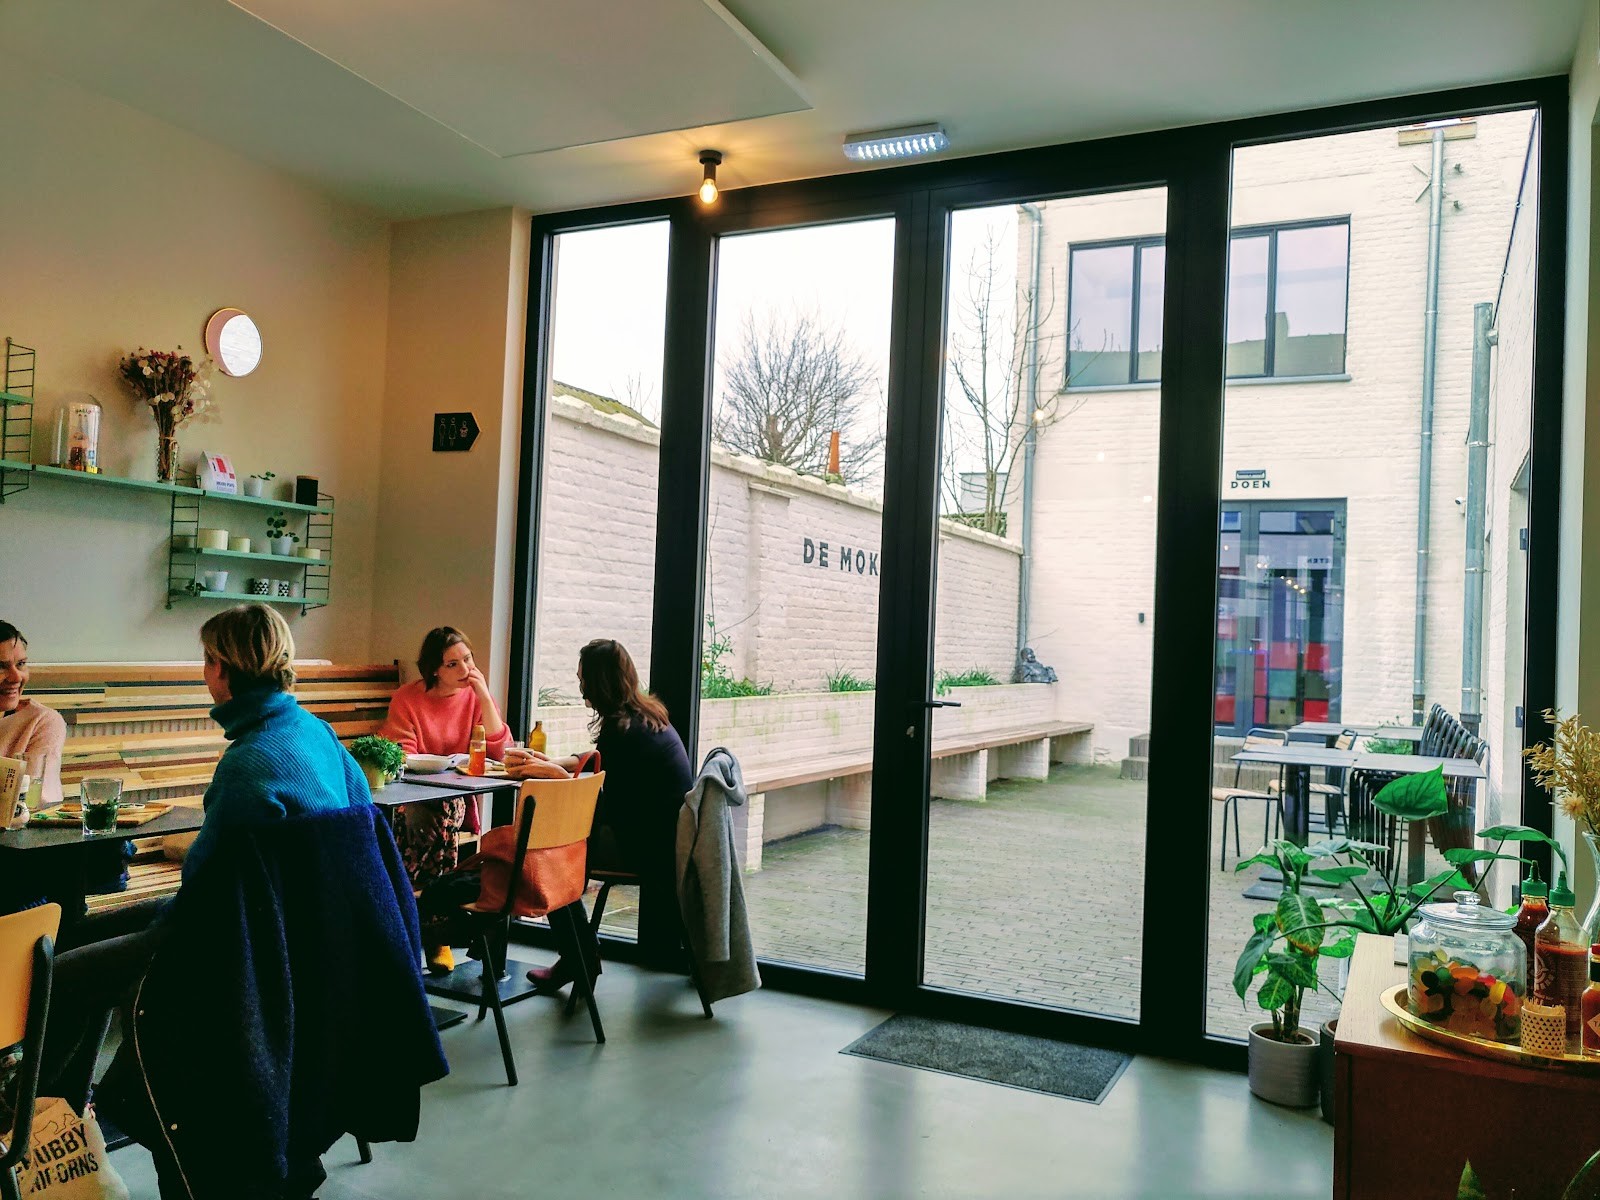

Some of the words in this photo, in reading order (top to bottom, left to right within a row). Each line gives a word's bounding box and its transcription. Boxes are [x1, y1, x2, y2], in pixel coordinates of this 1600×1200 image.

[1231, 480, 1270, 488] DOEN
[803, 537, 829, 568] DE
[840, 546, 879, 576] MOK
